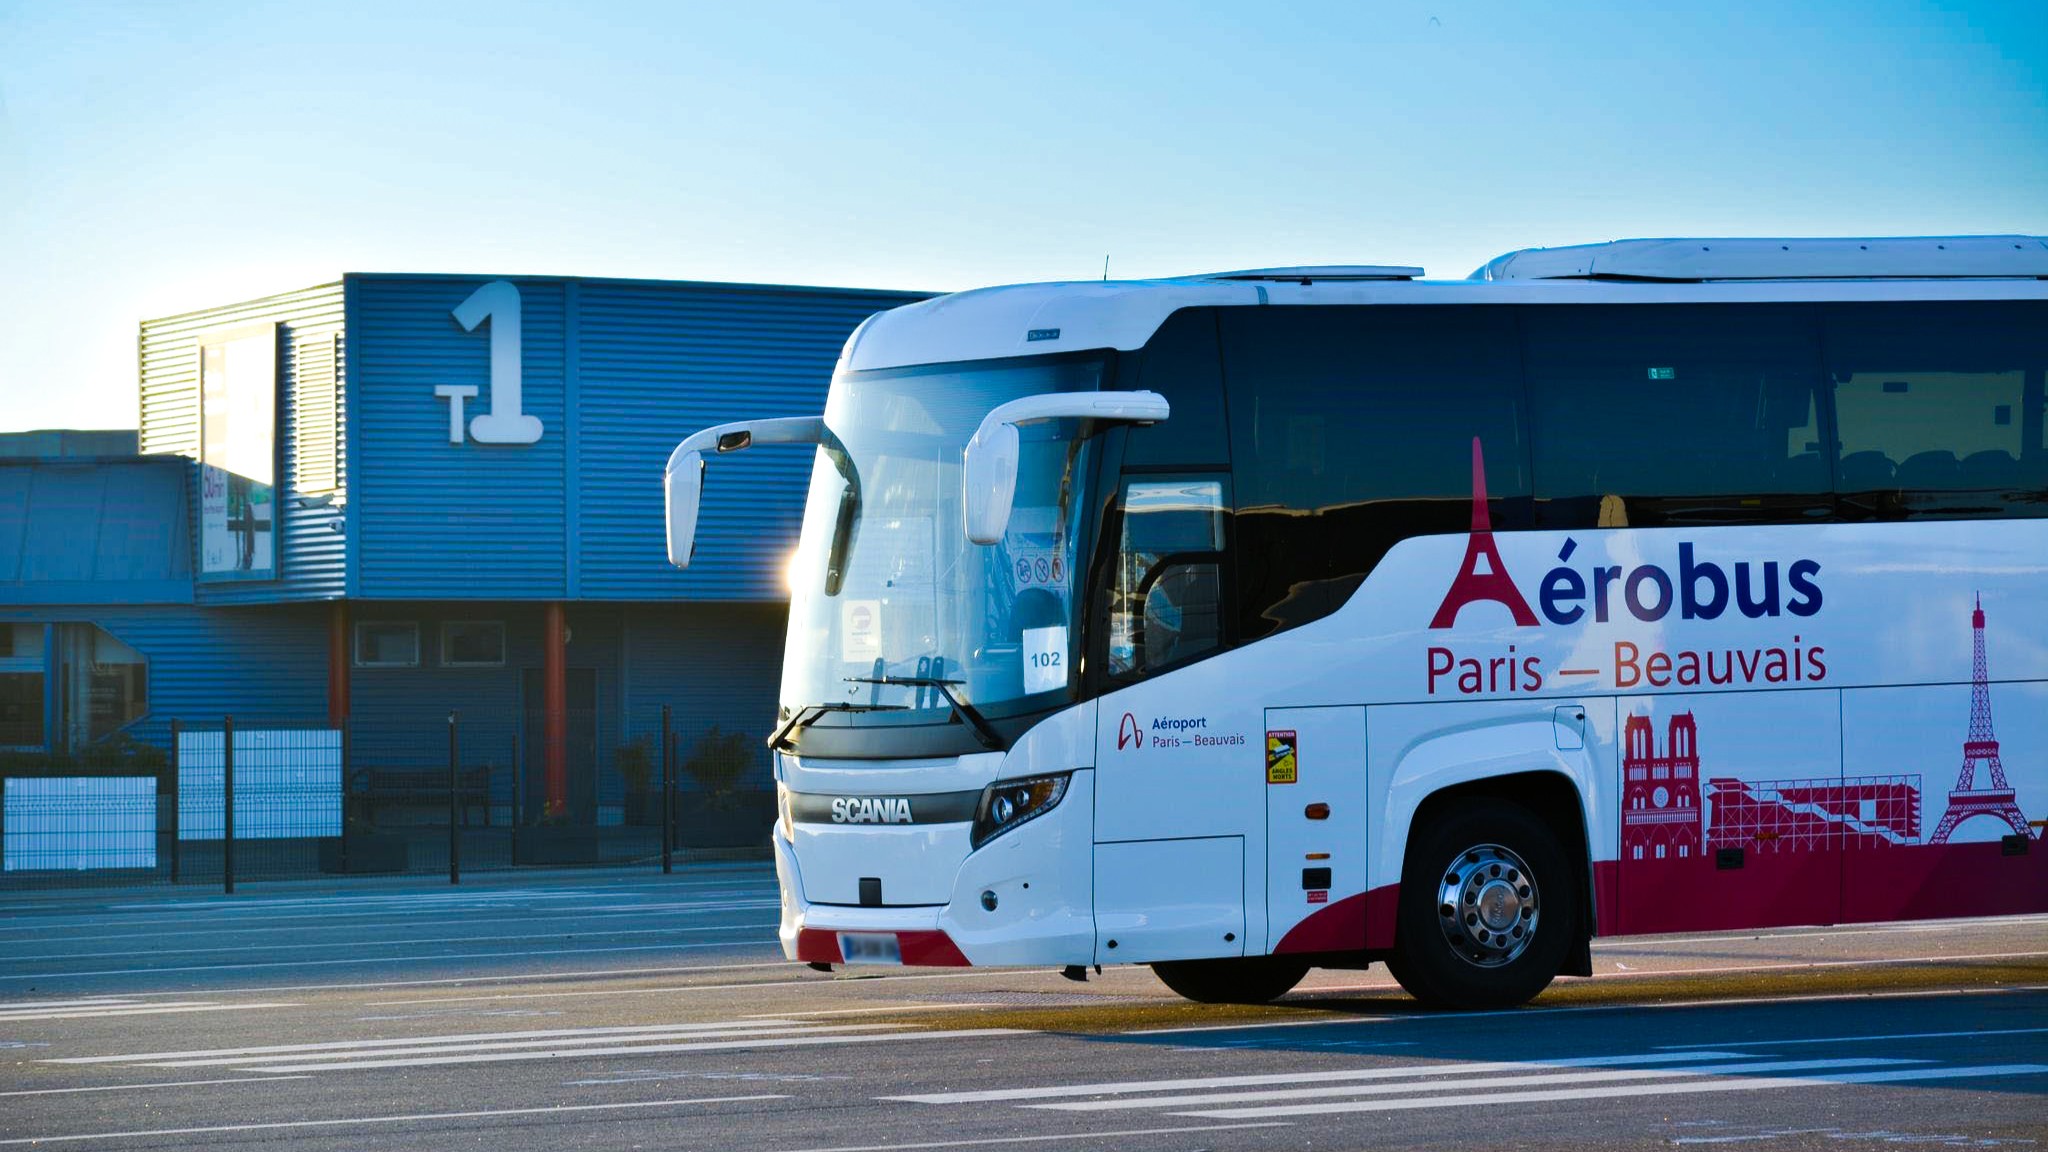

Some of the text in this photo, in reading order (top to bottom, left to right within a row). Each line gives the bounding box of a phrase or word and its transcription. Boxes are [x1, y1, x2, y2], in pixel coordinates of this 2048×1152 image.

[1428, 436, 1823, 628] Aérobus
[1031, 651, 1061, 668] 102
[1427, 645, 1542, 694] Paris
[1614, 635, 1827, 688] Beauvais
[1152, 716, 1207, 732] Aéroport
[1152, 735, 1180, 748] Paris
[1194, 733, 1245, 746] Beauvais
[831, 797, 913, 823] SCANIA
